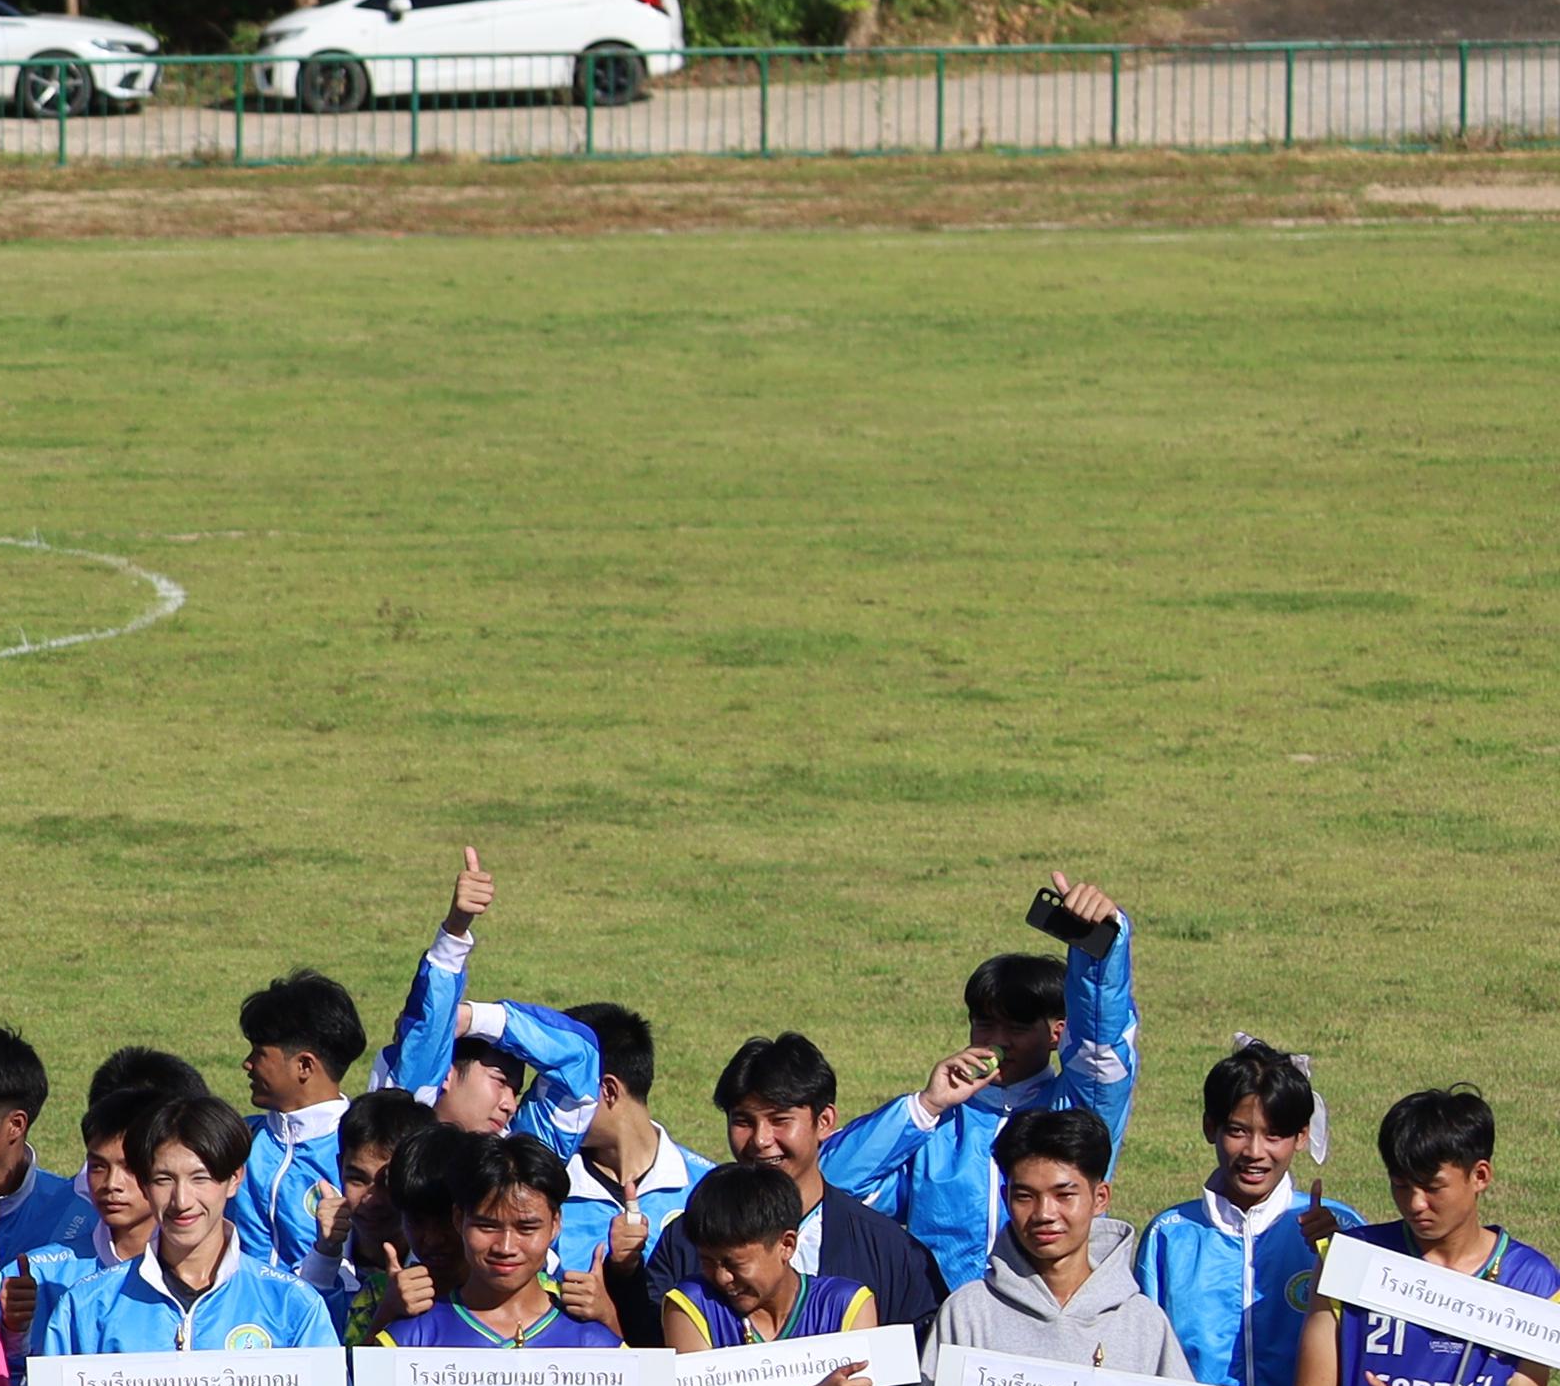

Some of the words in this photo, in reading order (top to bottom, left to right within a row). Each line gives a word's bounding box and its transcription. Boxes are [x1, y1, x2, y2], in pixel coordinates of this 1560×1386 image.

[1380, 1267, 1560, 1345] โรงเรียนสรรพวิทยาค
[1366, 1312, 1407, 1356] 21
[409, 1362, 545, 1386] โรงเรียนสบเมย
[551, 1364, 624, 1386] วิทยาคม
